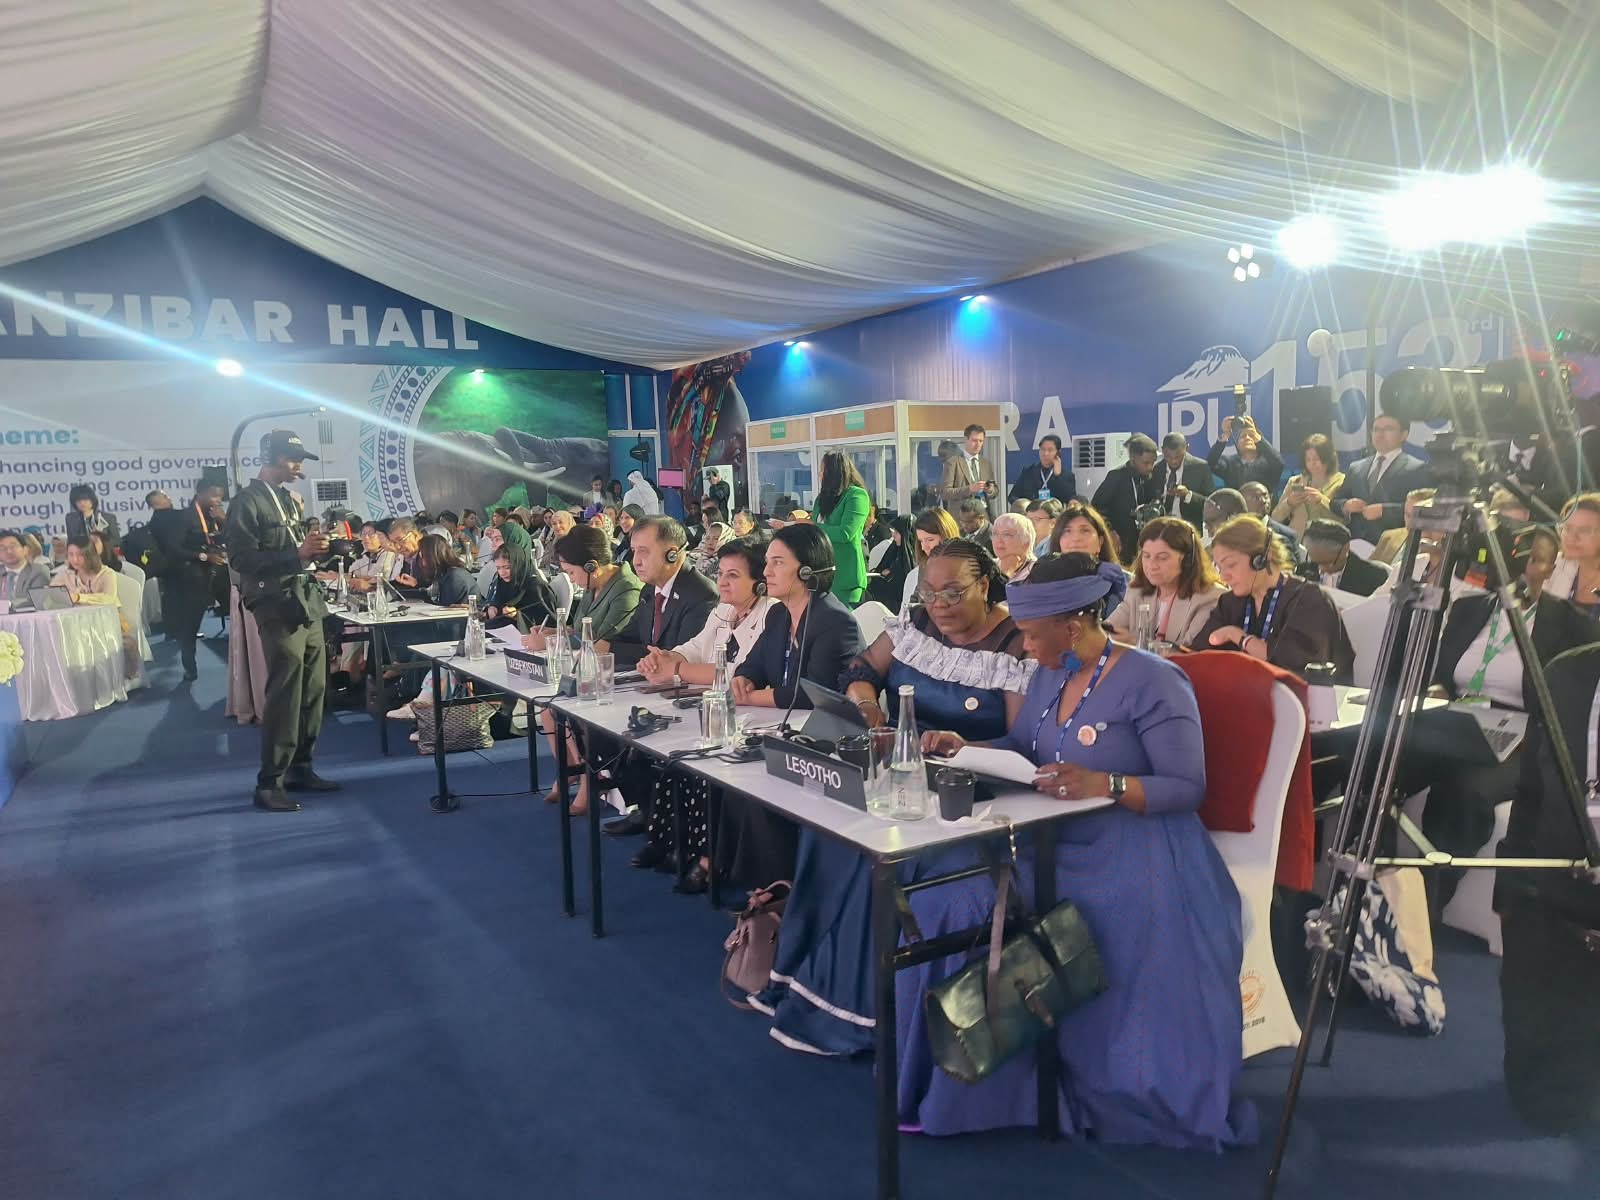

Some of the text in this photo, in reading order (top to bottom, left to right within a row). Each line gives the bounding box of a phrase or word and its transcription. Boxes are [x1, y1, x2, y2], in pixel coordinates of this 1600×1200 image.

[0, 290, 479, 350] NZIBAR HALL
[0, 456, 262, 476] hancing good governace
[786, 753, 841, 789] LESOTHO
